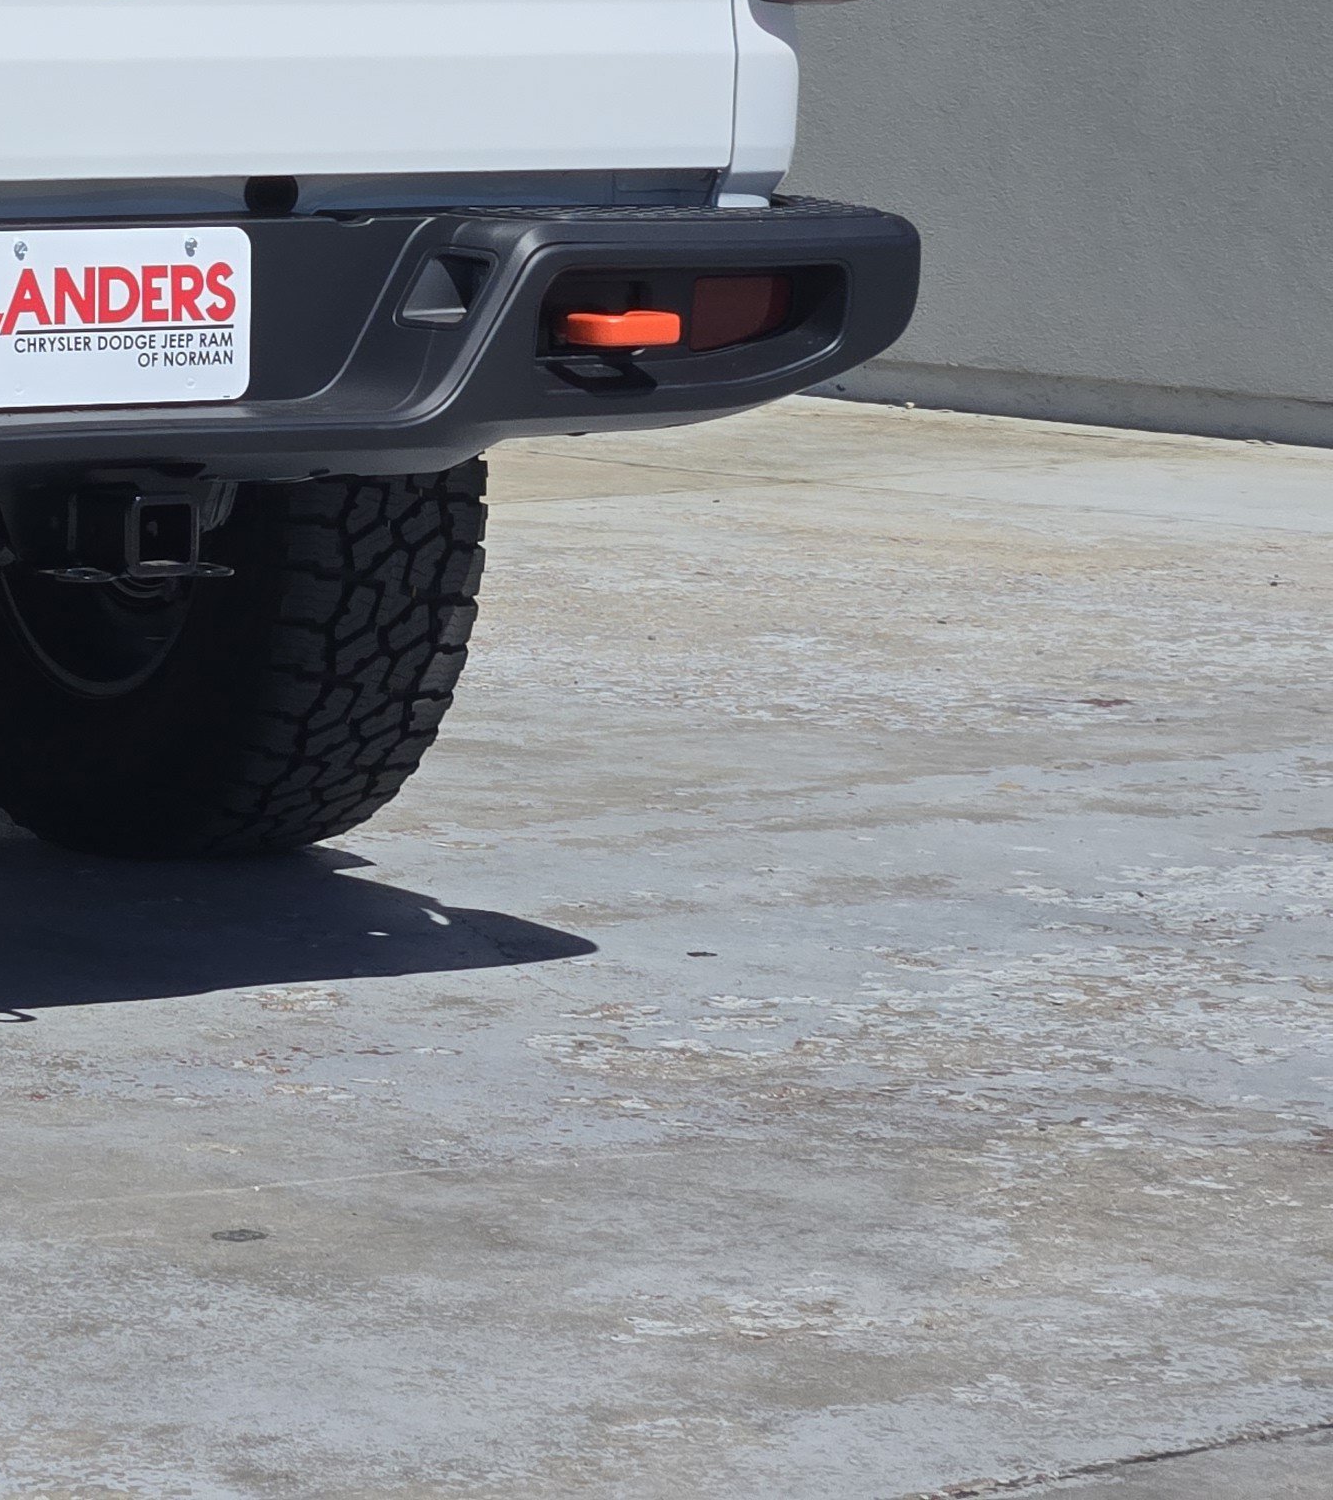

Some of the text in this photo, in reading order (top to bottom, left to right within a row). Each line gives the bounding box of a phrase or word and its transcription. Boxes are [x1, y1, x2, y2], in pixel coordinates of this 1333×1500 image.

[14, 332, 233, 353] CHRYSLER DODGE JEEP RAM
[137, 350, 233, 368] OF NORMAN
